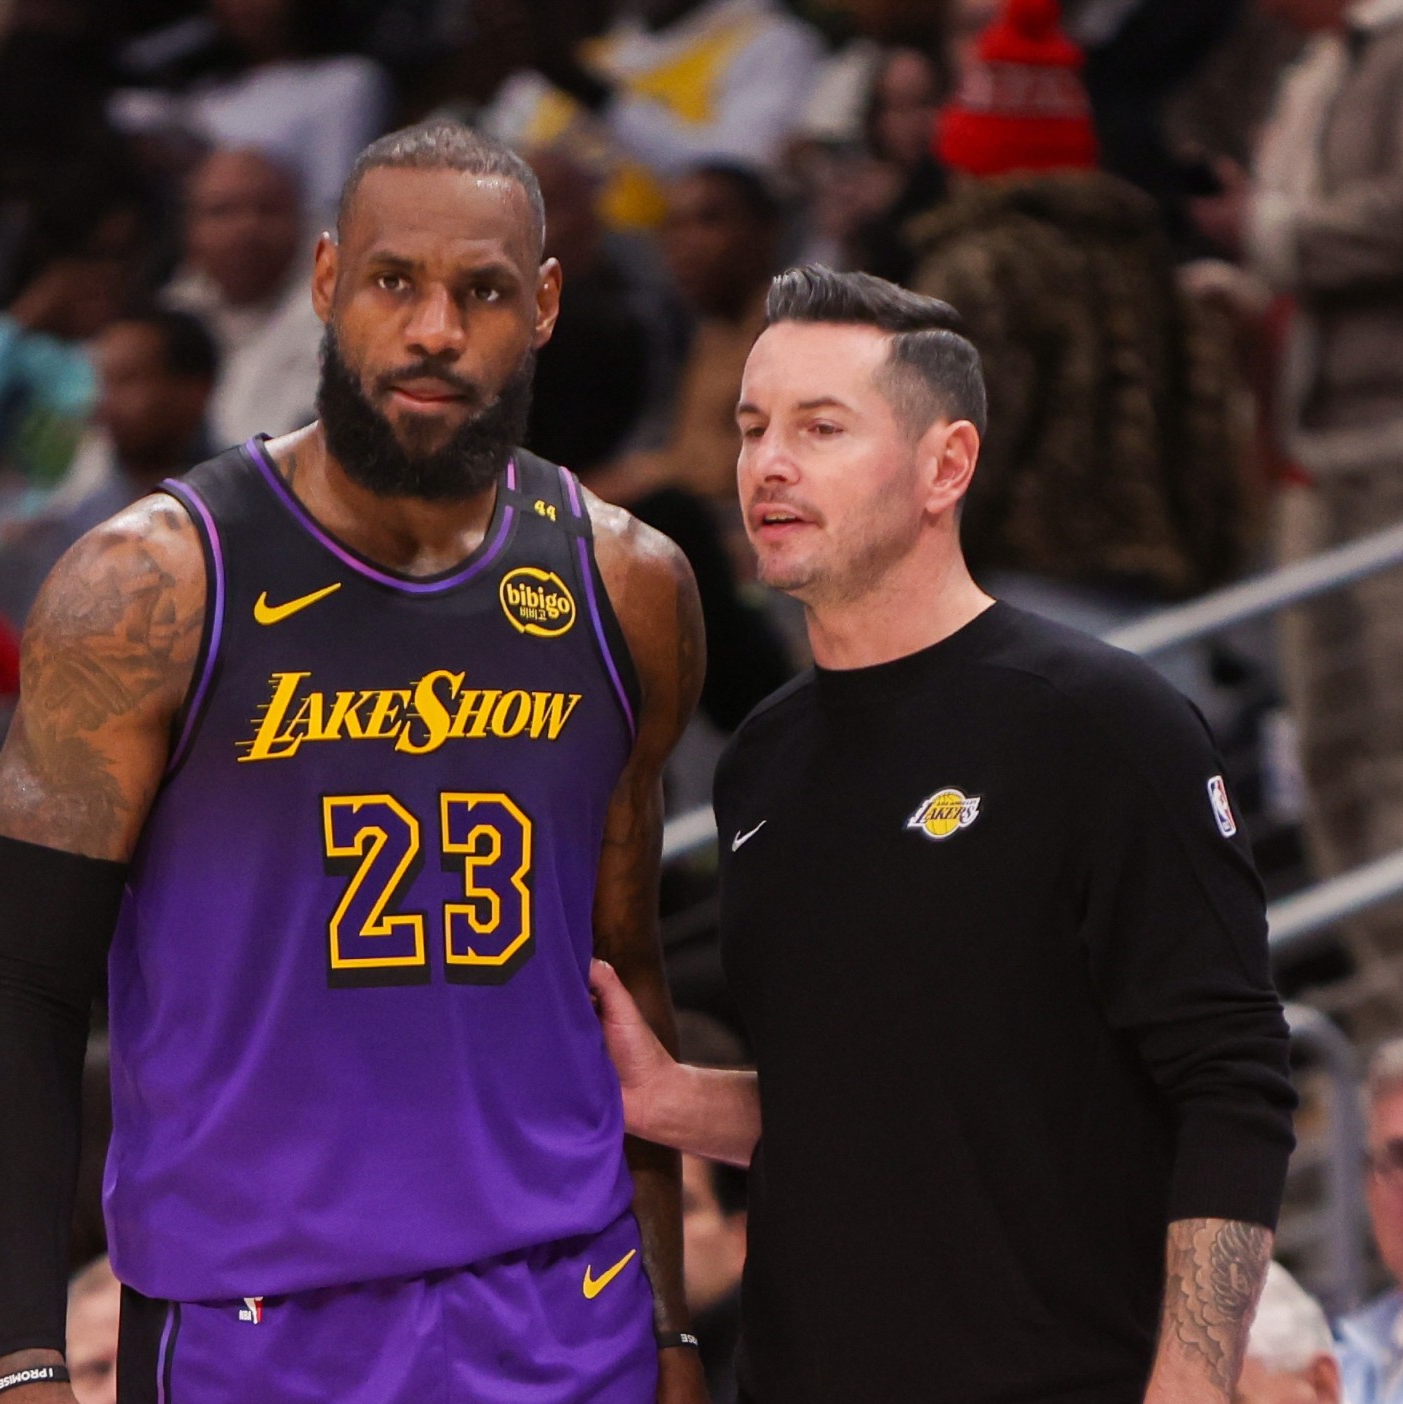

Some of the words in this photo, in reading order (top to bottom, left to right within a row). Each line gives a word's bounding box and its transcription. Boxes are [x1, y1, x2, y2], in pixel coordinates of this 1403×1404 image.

[507, 583, 571, 619] bibigo
[323, 792, 532, 969] 23
[48, 1367, 54, 1378] I
